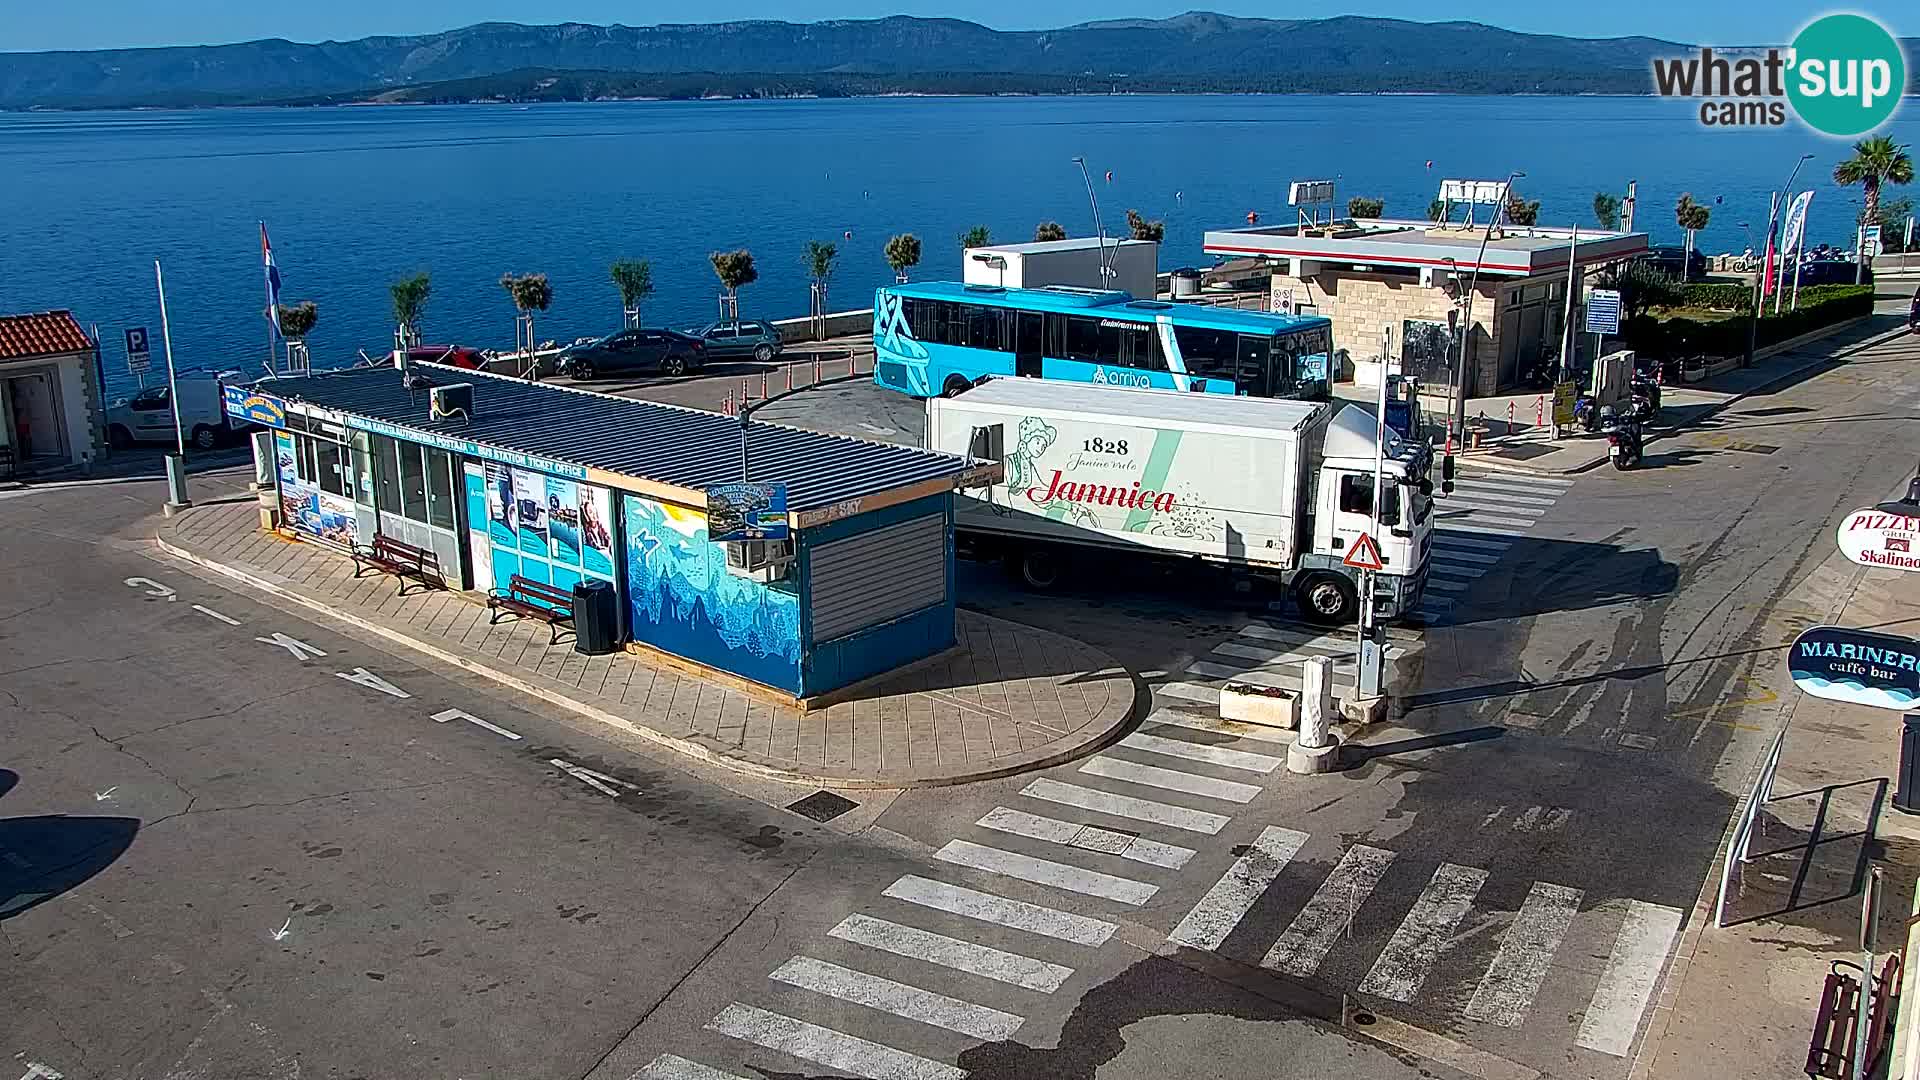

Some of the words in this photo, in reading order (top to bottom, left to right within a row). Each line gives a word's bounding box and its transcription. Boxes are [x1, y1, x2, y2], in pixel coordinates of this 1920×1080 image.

[130, 331, 142, 349] P
[1109, 371, 1150, 389] arriva
[1083, 437, 1129, 456] 1828
[437, 437, 467, 451] POSTAJA
[478, 447, 493, 459] BUS
[494, 449, 526, 464] STATION
[528, 456, 554, 470] TICKET
[555, 461, 583, 477] OFFICE
[1026, 469, 1176, 513] Jamnica
[1849, 514, 1920, 533] PIZZE
[1882, 530, 1916, 540] GRILL
[1801, 642, 1920, 673] MARINER
[1829, 661, 1866, 676] caffe
[1870, 666, 1897, 680] bar
